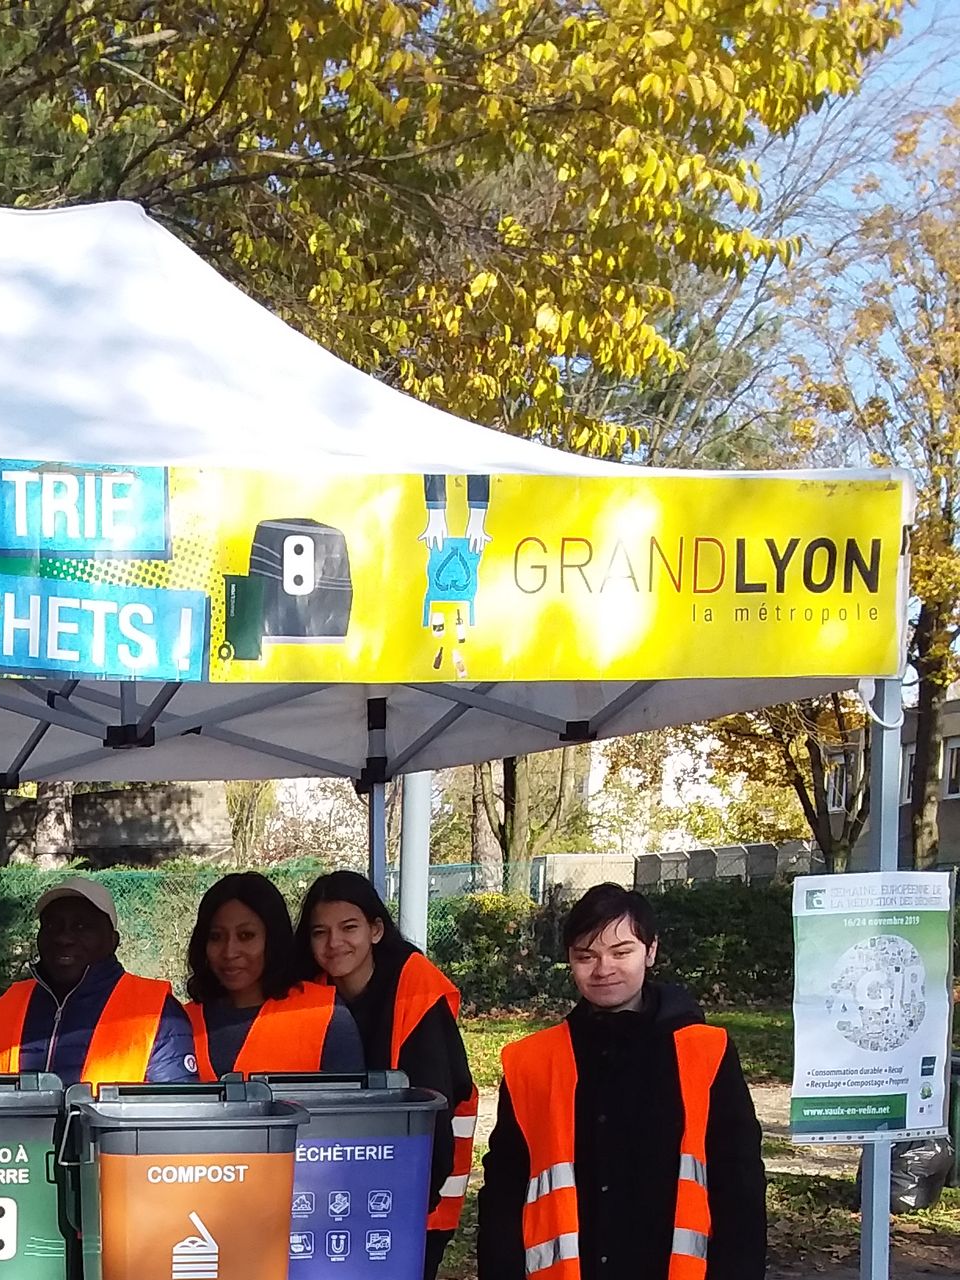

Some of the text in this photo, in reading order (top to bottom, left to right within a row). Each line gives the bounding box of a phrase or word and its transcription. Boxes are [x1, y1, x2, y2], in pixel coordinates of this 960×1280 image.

[2, 471, 136, 539] TRIE
[513, 536, 881, 595] GRANDLYON
[691, 602, 879, 626] la métropole
[868, 916, 904, 926] novembre
[904, 915, 920, 925] 2019
[811, 1067, 859, 1077] Consommation
[859, 1066, 882, 1076] durable
[809, 1080, 841, 1090] Recyclage
[847, 1079, 885, 1089] Compostage
[803, 1105, 891, 1116] www.vaulx-en-velin.net
[14, 1144, 29, 1163] À
[295, 1144, 394, 1162] ÉCHÈTERIE
[147, 1165, 249, 1184] COMPOST
